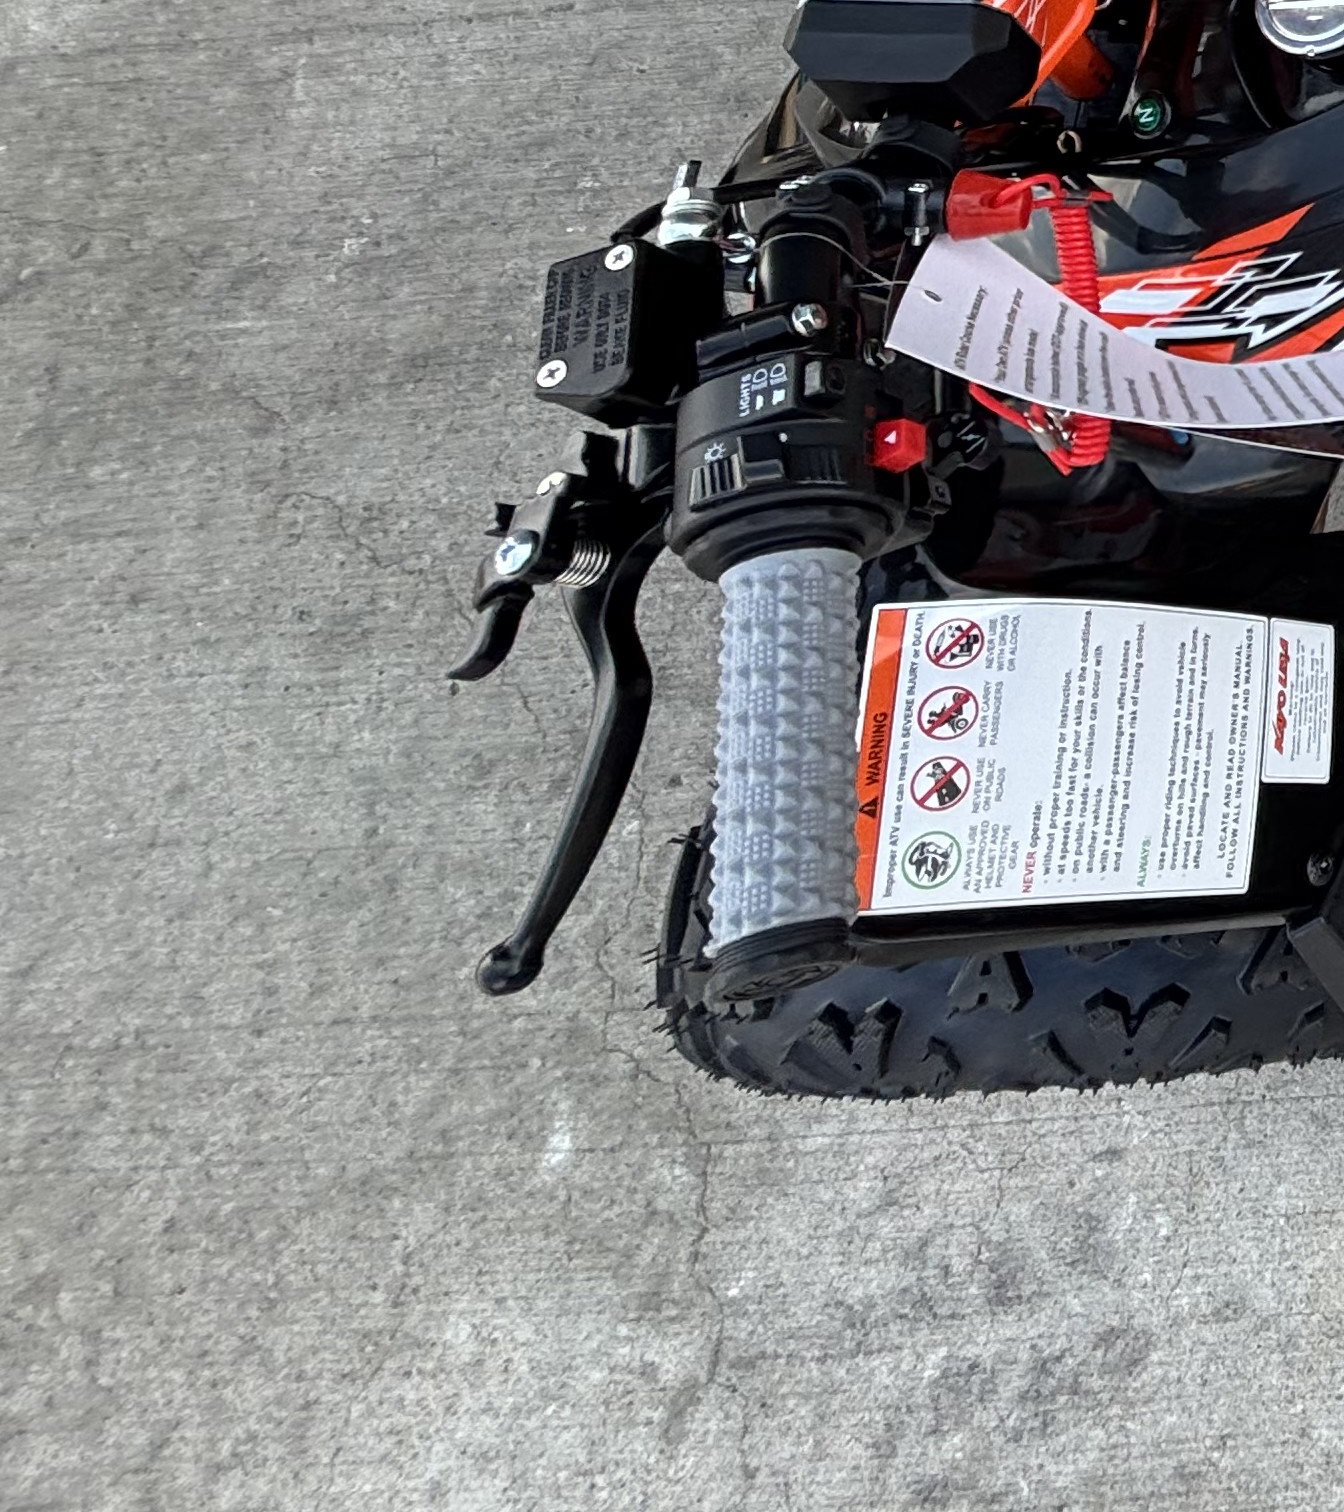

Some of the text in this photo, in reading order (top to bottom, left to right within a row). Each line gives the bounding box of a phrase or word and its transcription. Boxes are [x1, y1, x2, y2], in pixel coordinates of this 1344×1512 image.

[738, 373, 752, 418] LIGHTS
[912, 611, 925, 646] DEATH.
[985, 618, 998, 669] NEVER USE
[996, 614, 1009, 671] WITH DRUGS
[912, 648, 920, 659] or
[1006, 658, 1016, 672] OR
[1094, 645, 1103, 667] with
[1120, 640, 1130, 679] balance
[906, 661, 918, 695] INJURY
[1077, 666, 1087, 682] the
[1077, 685, 1085, 696] or
[1091, 669, 1101, 699] occur
[977, 680, 992, 747] NEVER CARRY
[989, 681, 1003, 745] PASSENGERS
[1074, 699, 1084, 726] skills
[1089, 702, 1098, 721] can
[1117, 681, 1127, 711] affect
[1242, 688, 1250, 711] AND
[901, 698, 914, 738] SEVERE
[866, 712, 888, 785] WARNING
[900, 740, 910, 750] in
[1072, 729, 1081, 754] your
[1084, 724, 1095, 770] collision
[1113, 622, 1145, 872] and steering and increase risk of losing control.
[1158, 641, 1186, 870] use proper riding techniques to avoid vehicle
[1170, 626, 1199, 870] overturns on hills and rough terrain and in turns.
[1181, 633, 1211, 870] avoid paved surfaces pavement may seriously
[1204, 729, 1214, 767] control.
[1235, 715, 1248, 798] INSTRUCTIONS
[898, 752, 908, 781] result
[1042, 669, 1072, 875] without proper training or instruction.
[1068, 756, 1078, 772] for
[1225, 748, 1235, 779] READ
[896, 783, 904, 801] can
[971, 757, 985, 814] NEVER USE
[982, 758, 996, 811] ON PUBLIC
[994, 767, 1006, 802] ROADS
[1065, 775, 1077, 796] fast
[1223, 783, 1232, 808] AND
[894, 804, 903, 823] use
[1063, 798, 1074, 817] too
[1196, 792, 1209, 837] handling
[1232, 802, 1241, 824] ALL
[889, 826, 900, 846] ATV
[1059, 820, 1071, 860] speeds
[1074, 821, 1085, 856] public
[1086, 785, 1103, 873] another vehicle.
[1217, 812, 1230, 859] LOCATE
[962, 824, 978, 890] ALWAYS USE
[973, 820, 989, 893] AN APPROVED
[984, 823, 1000, 889] HELMET AND
[995, 825, 1011, 887] PROTECTIVE
[1008, 840, 1019, 869] GEAR
[1022, 801, 1042, 893] NEVER operate:
[1099, 849, 1109, 873] with
[1137, 836, 1151, 887] ALWAYS:
[1193, 839, 1203, 869] affect
[1225, 828, 1238, 878] FOLLOW
[1057, 863, 1066, 875] at
[1071, 859, 1080, 874] on
